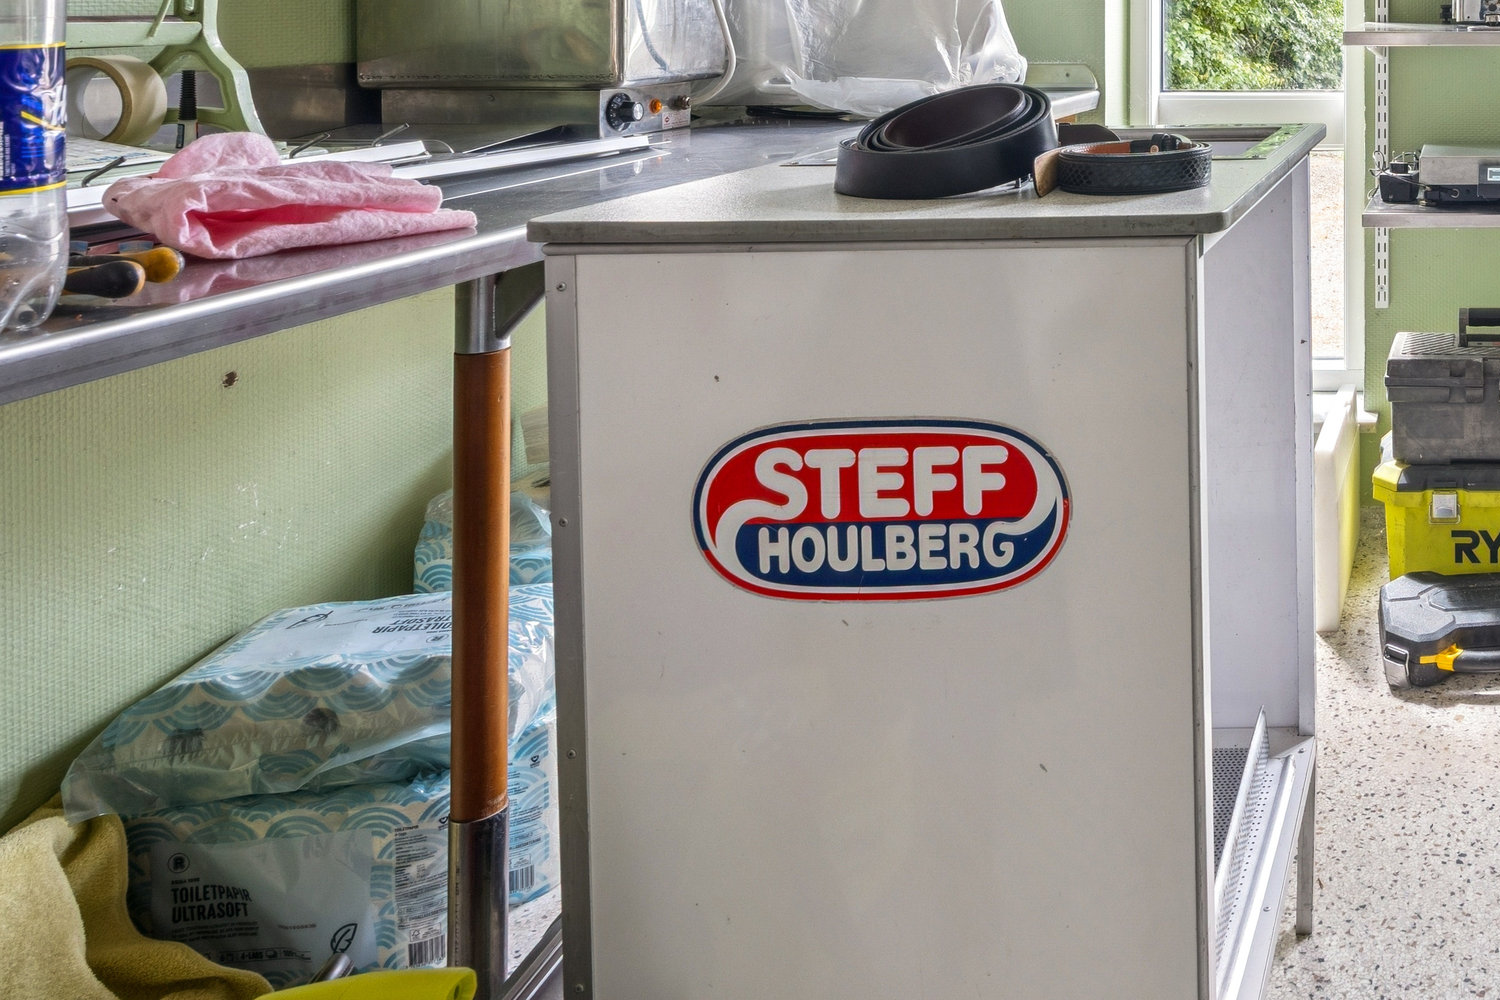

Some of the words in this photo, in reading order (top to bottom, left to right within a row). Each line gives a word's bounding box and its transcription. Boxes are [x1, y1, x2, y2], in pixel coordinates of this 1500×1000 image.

[755, 446, 1009, 520] STEFF
[758, 523, 1015, 574] HOULBERG
[172, 885, 252, 904] TOILETPAPIR
[172, 903, 249, 923] ULTRASOFT
